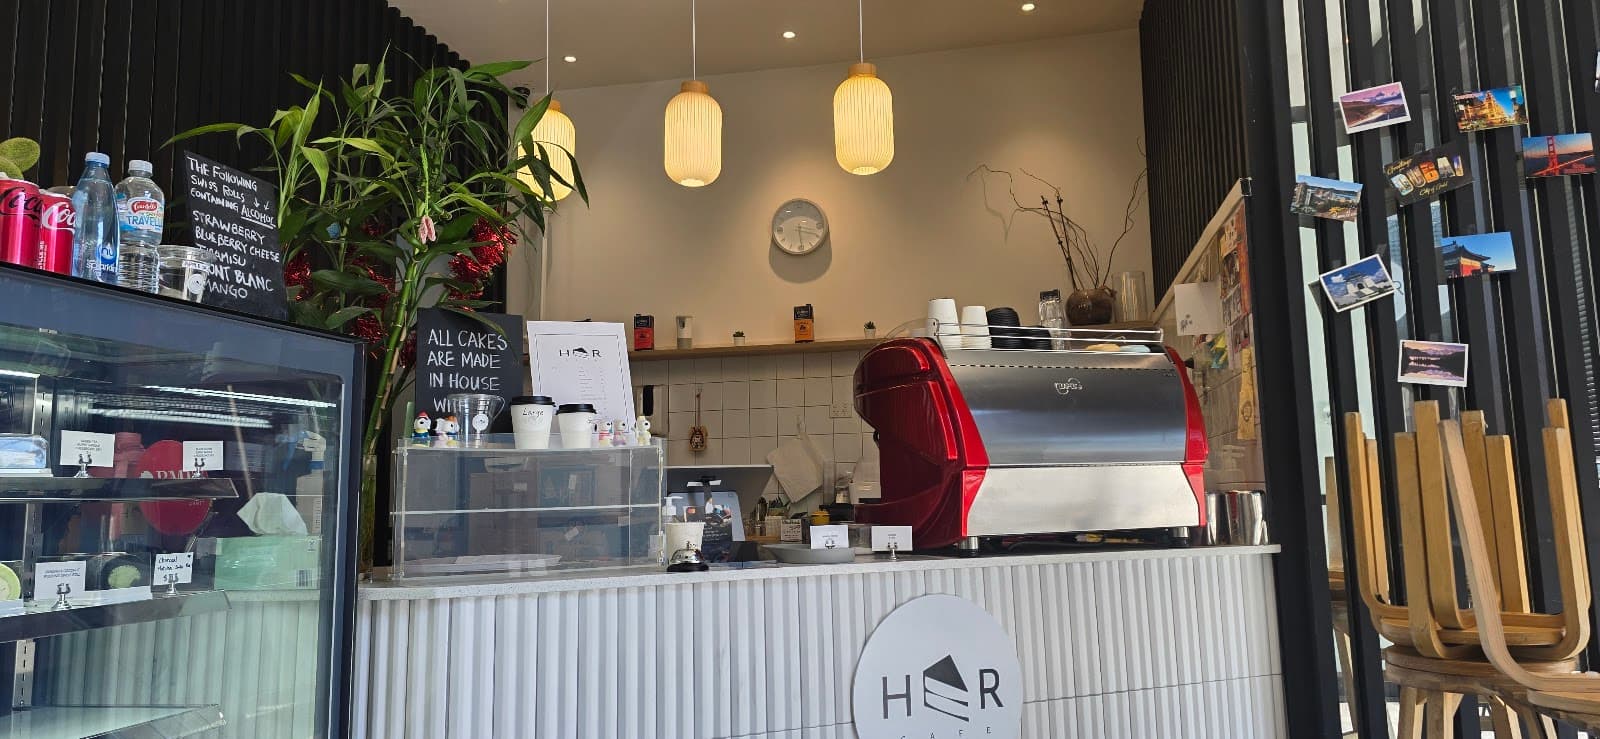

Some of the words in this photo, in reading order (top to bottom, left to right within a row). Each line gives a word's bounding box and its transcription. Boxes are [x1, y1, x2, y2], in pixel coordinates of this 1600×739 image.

[186, 156, 210, 176] THE
[1390, 155, 1464, 196] DUBAI
[190, 174, 218, 193] SWISS
[222, 184, 245, 203] ROLLS
[192, 210, 266, 245] STRAWBERRY
[241, 204, 276, 228] ALCOHOL
[195, 226, 248, 254] BLUEBERRY
[249, 246, 280, 263] CHEESE
[206, 263, 231, 283] ONT
[234, 269, 275, 292] BLANC
[427, 328, 454, 347] ALL
[458, 330, 508, 351] CAKES
[426, 350, 456, 367] ARE
[461, 351, 502, 369] MADE
[429, 372, 443, 388] IN
[448, 372, 501, 391] HOUSE
